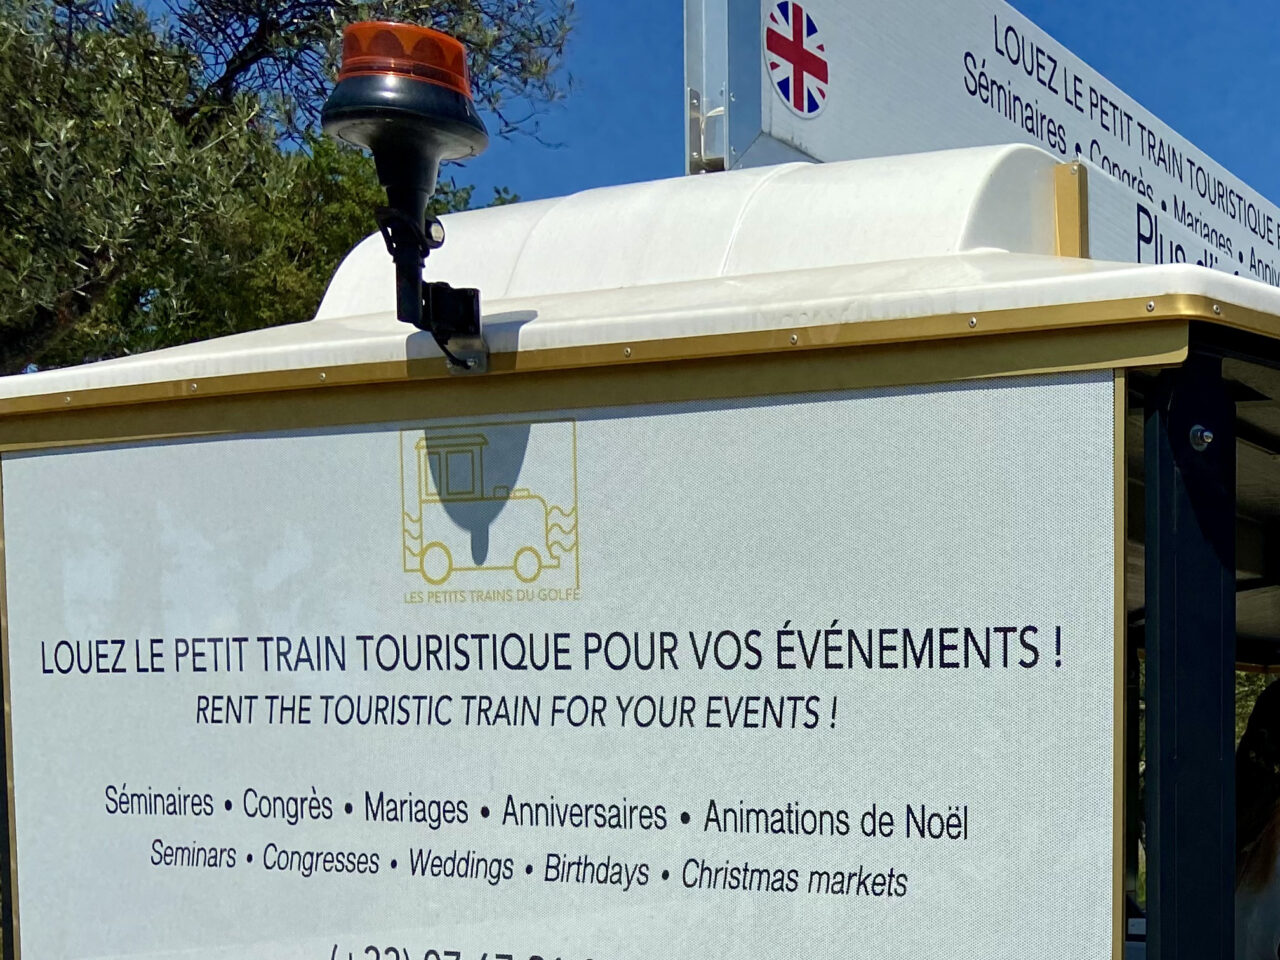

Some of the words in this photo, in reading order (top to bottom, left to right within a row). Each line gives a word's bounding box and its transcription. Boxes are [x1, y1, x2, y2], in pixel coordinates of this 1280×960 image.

[963, 51, 1067, 155] Séminaires
[993, 14, 1059, 95] LOUEZ
[1063, 66, 1085, 114] LE
[1089, 86, 1133, 147] PETIT
[1137, 121, 1184, 184] TRAIN
[1187, 157, 1274, 246] TOURISTIQUE
[404, 591, 425, 604] LES
[427, 590, 468, 603] PETITS
[469, 589, 514, 603] TRAINS
[516, 588, 536, 602] DU
[537, 587, 581, 602] GOLFE
[41, 639, 127, 675] LOUEZ
[135, 638, 165, 673] LE
[174, 636, 249, 673] PETIT
[256, 635, 346, 672] TRAIN
[355, 632, 572, 672] TOURISTIQUE
[584, 630, 680, 671] POUR
[688, 628, 763, 671] VOS
[776, 618, 1041, 670] ÉVÉNEMENTS
[196, 695, 259, 724] RENT
[264, 694, 313, 725] THE
[319, 694, 453, 727] TOURISTIC
[460, 695, 541, 727] TRAIN
[550, 694, 607, 728] FOR
[615, 694, 697, 729] YOUR
[705, 694, 821, 730] EVENTS
[105, 784, 214, 817] Séminaires
[243, 785, 333, 826] Congrès
[364, 790, 469, 831] Mariages
[501, 794, 668, 831] Anniversaires
[703, 798, 851, 837] Animations
[859, 802, 896, 838] de
[906, 803, 968, 841] Noël
[150, 838, 237, 869] Seminars
[263, 842, 380, 878] Congresses
[409, 847, 515, 887] Weddings
[543, 852, 650, 893] Birthdays
[682, 857, 799, 893] Christmas
[807, 864, 909, 898] markets
